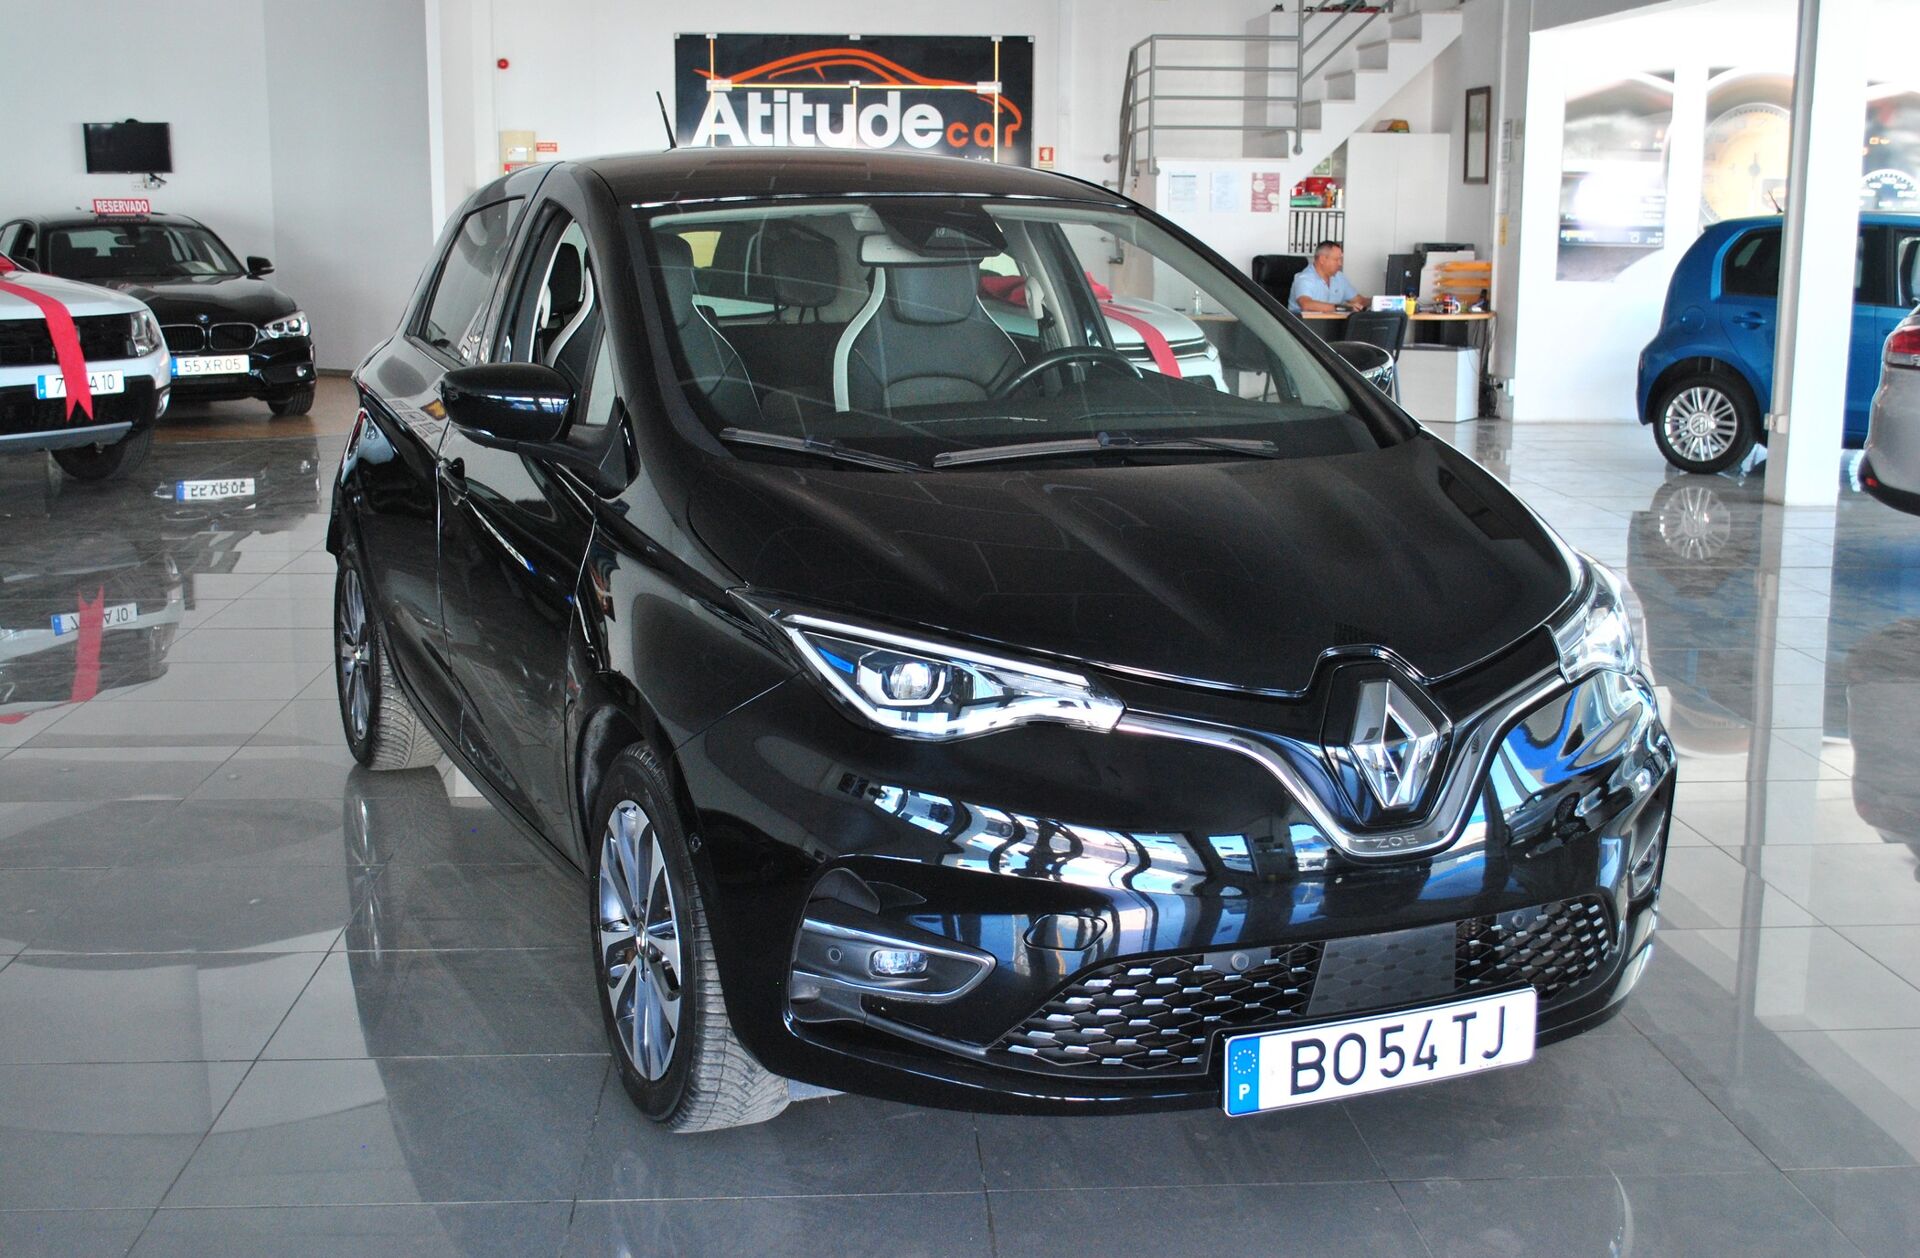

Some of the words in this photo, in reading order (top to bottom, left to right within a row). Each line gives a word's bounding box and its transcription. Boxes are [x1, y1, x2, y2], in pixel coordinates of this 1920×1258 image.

[691, 90, 944, 149] Atitude
[946, 121, 1022, 148] car
[96, 200, 149, 213] RESERVADO
[184, 361, 202, 373] 55
[204, 359, 222, 372] XR
[225, 358, 241, 370] 05
[102, 374, 115, 390] 10
[1376, 834, 1419, 849] ZOE
[1290, 1032, 1367, 1096] BO
[1379, 1018, 1438, 1079] 54
[1451, 1005, 1506, 1066] TJ
[1238, 1083, 1251, 1100] P
